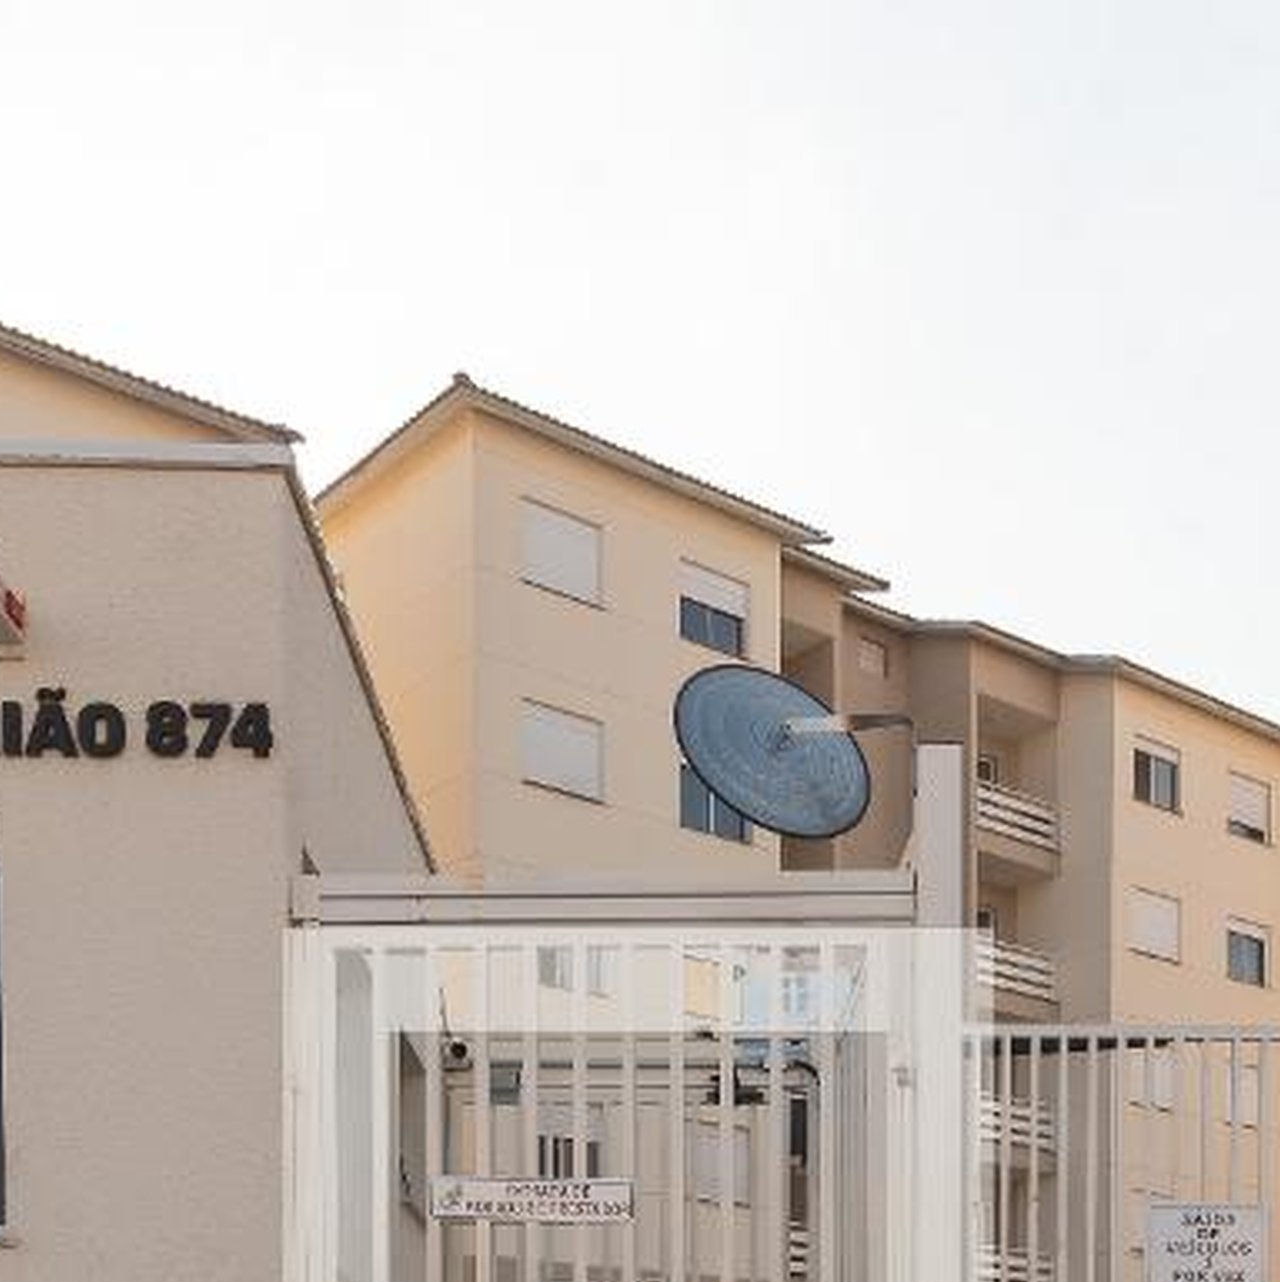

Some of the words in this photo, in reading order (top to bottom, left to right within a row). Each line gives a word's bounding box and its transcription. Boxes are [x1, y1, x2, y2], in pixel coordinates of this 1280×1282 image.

[144, 699, 275, 760] 874
[1197, 1228, 1219, 1239] DE
[1172, 1271, 1208, 1282] POR
